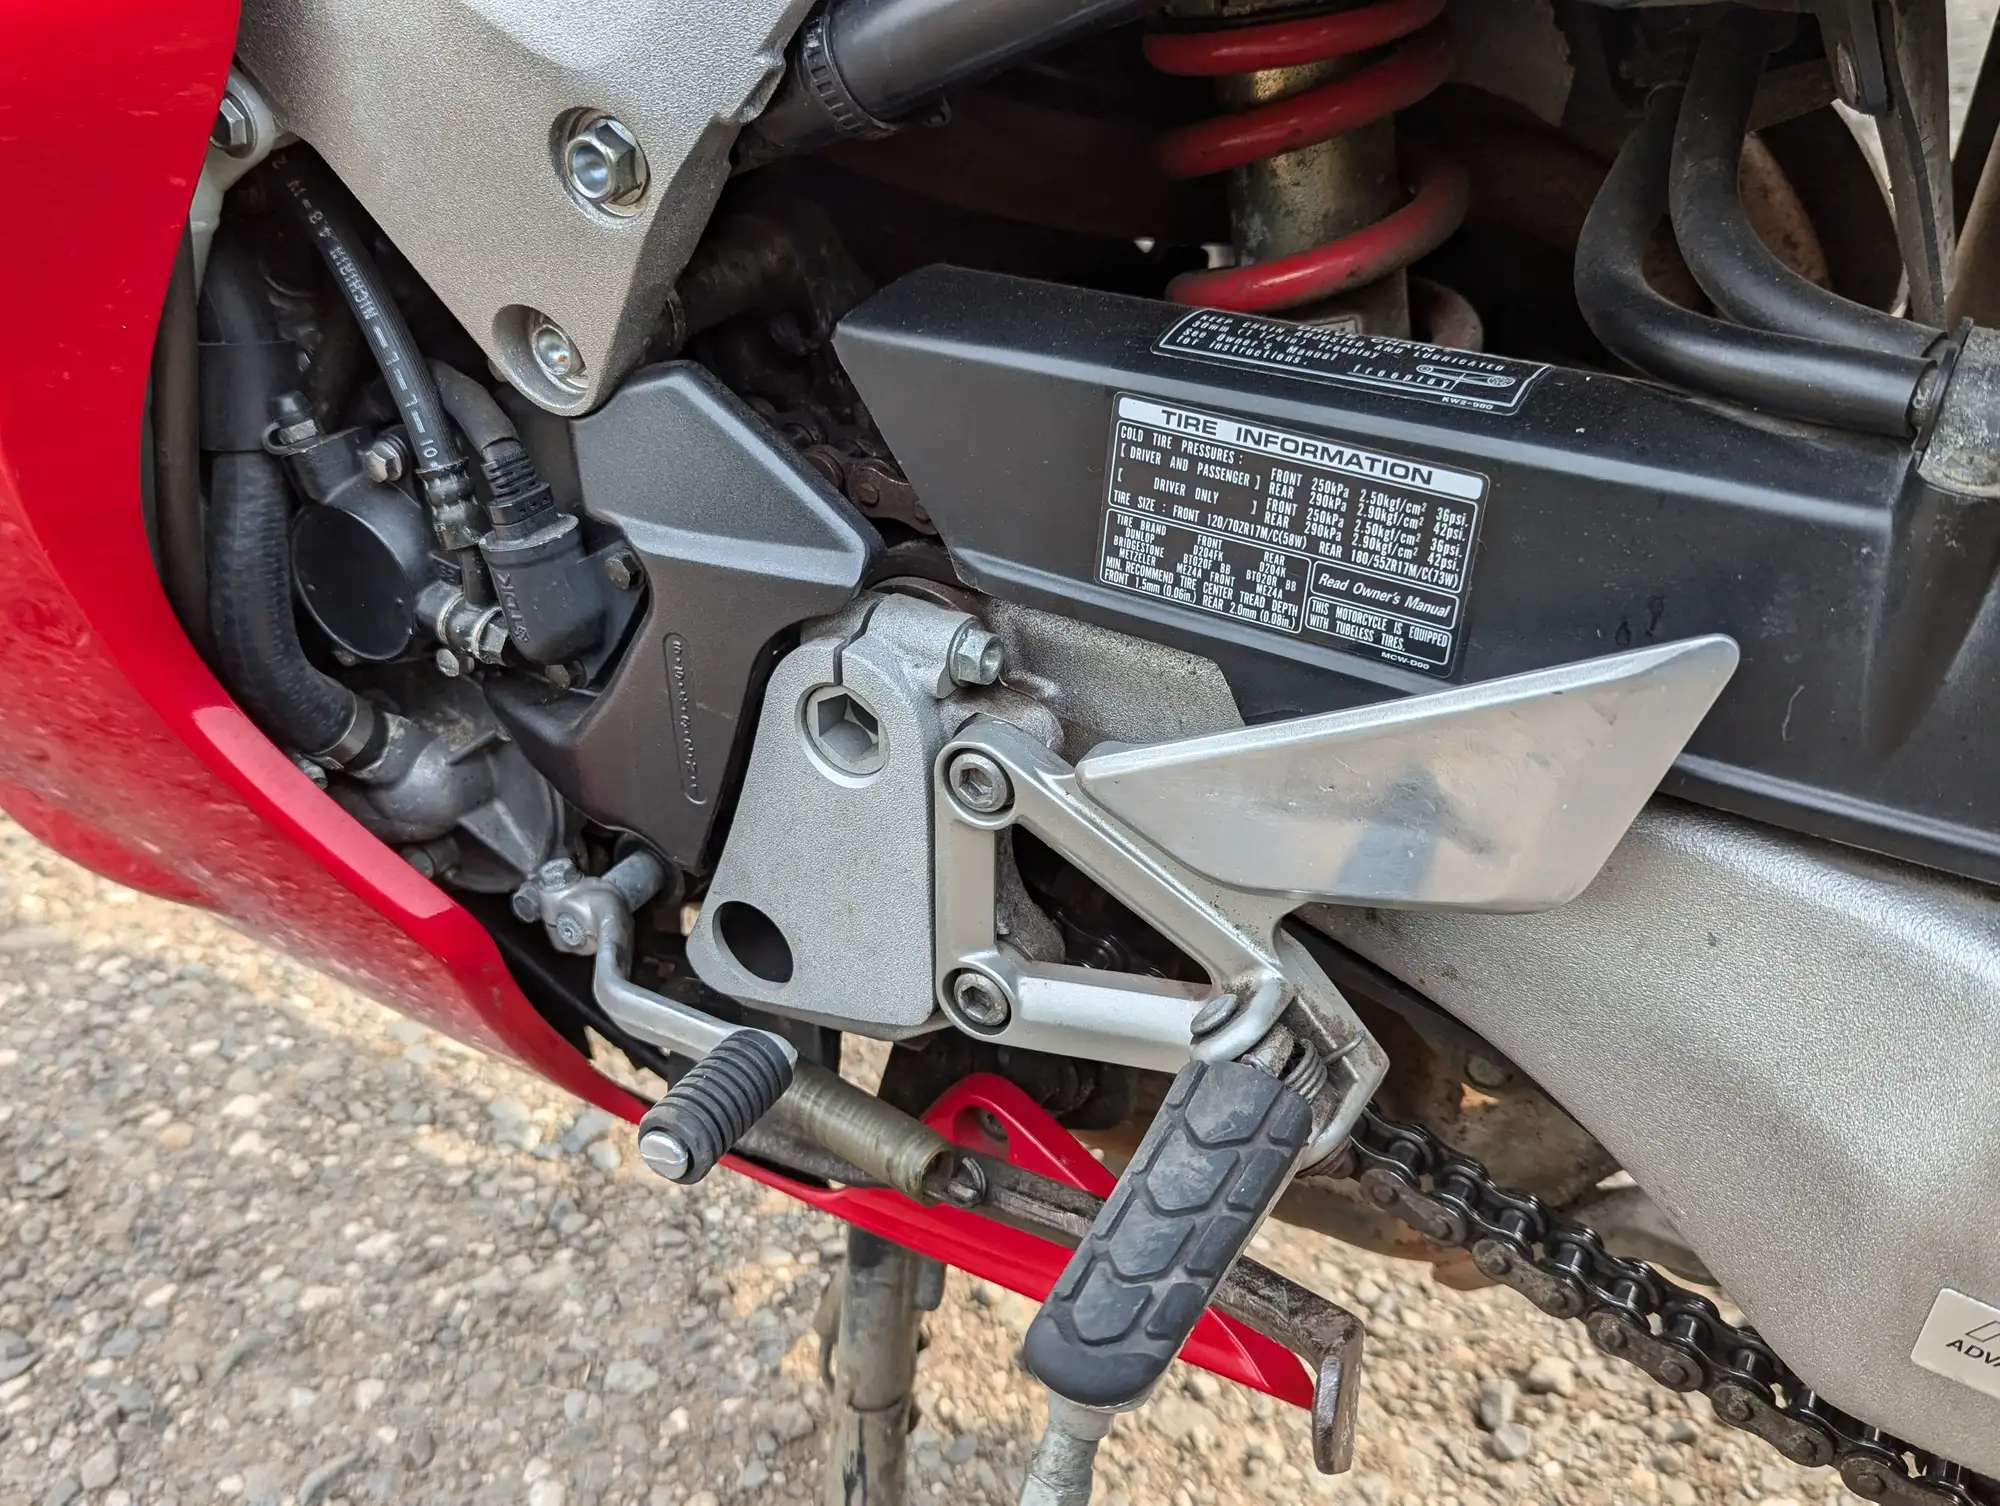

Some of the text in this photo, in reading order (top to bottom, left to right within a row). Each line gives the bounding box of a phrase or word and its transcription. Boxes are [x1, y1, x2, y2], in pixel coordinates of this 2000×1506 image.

[1120, 425, 1144, 443] COLD
[1151, 432, 1172, 449] TIRE
[1160, 408, 1433, 485] TIRE INFORMATION
[1169, 455, 1189, 472] AND
[1153, 477, 1186, 497] DRIVER
[1194, 487, 1219, 505] ONLY
[1268, 481, 1294, 500] REAR
[1308, 490, 1347, 513] 290kPa
[1432, 520, 1468, 544] 42psi.
[1270, 467, 1302, 487] FRONT
[1310, 476, 1350, 498] 250kPa
[1434, 506, 1471, 530] 36psi.
[1112, 489, 1131, 506] TIRE
[1172, 504, 1199, 523] FRONT
[1206, 512, 1307, 549] 120/70ZR17M/C(58W)
[1318, 540, 1342, 558] REAR
[1350, 548, 1459, 588] 180/55ZR17M/C(73W)
[1113, 535, 1164, 558] BRIDGESTONE
[1219, 562, 1231, 575] BB
[1116, 513, 1285, 566] TIRE BRAND FRONT REAR
[1125, 527, 1286, 578] DUNLOP D204FK D204K
[1264, 510, 1290, 529] REAR
[1304, 520, 1342, 542] 290kPa
[1426, 550, 1462, 575] 42psi.
[1266, 497, 1298, 517] FRONT
[1306, 506, 1345, 528] 250kPa
[1429, 536, 1465, 560] 36psi.
[1104, 568, 1296, 630] FRONT 1.5mm (0.06in.) REAR 2.0mm (0.08in.)
[1105, 555, 1298, 617] MIN. RECOMMEND TIRE CENTER TREAD DEPTH
[1118, 547, 1283, 600] METZELER MEZ4A FRONT MEZ4A
[1318, 572, 1451, 619] Read Owner's Manual
[1308, 613, 1407, 652] WITH TUBELESS TIRES.
[1310, 599, 1448, 648] THIS MOTORCYCLE IS EQUIPPED
